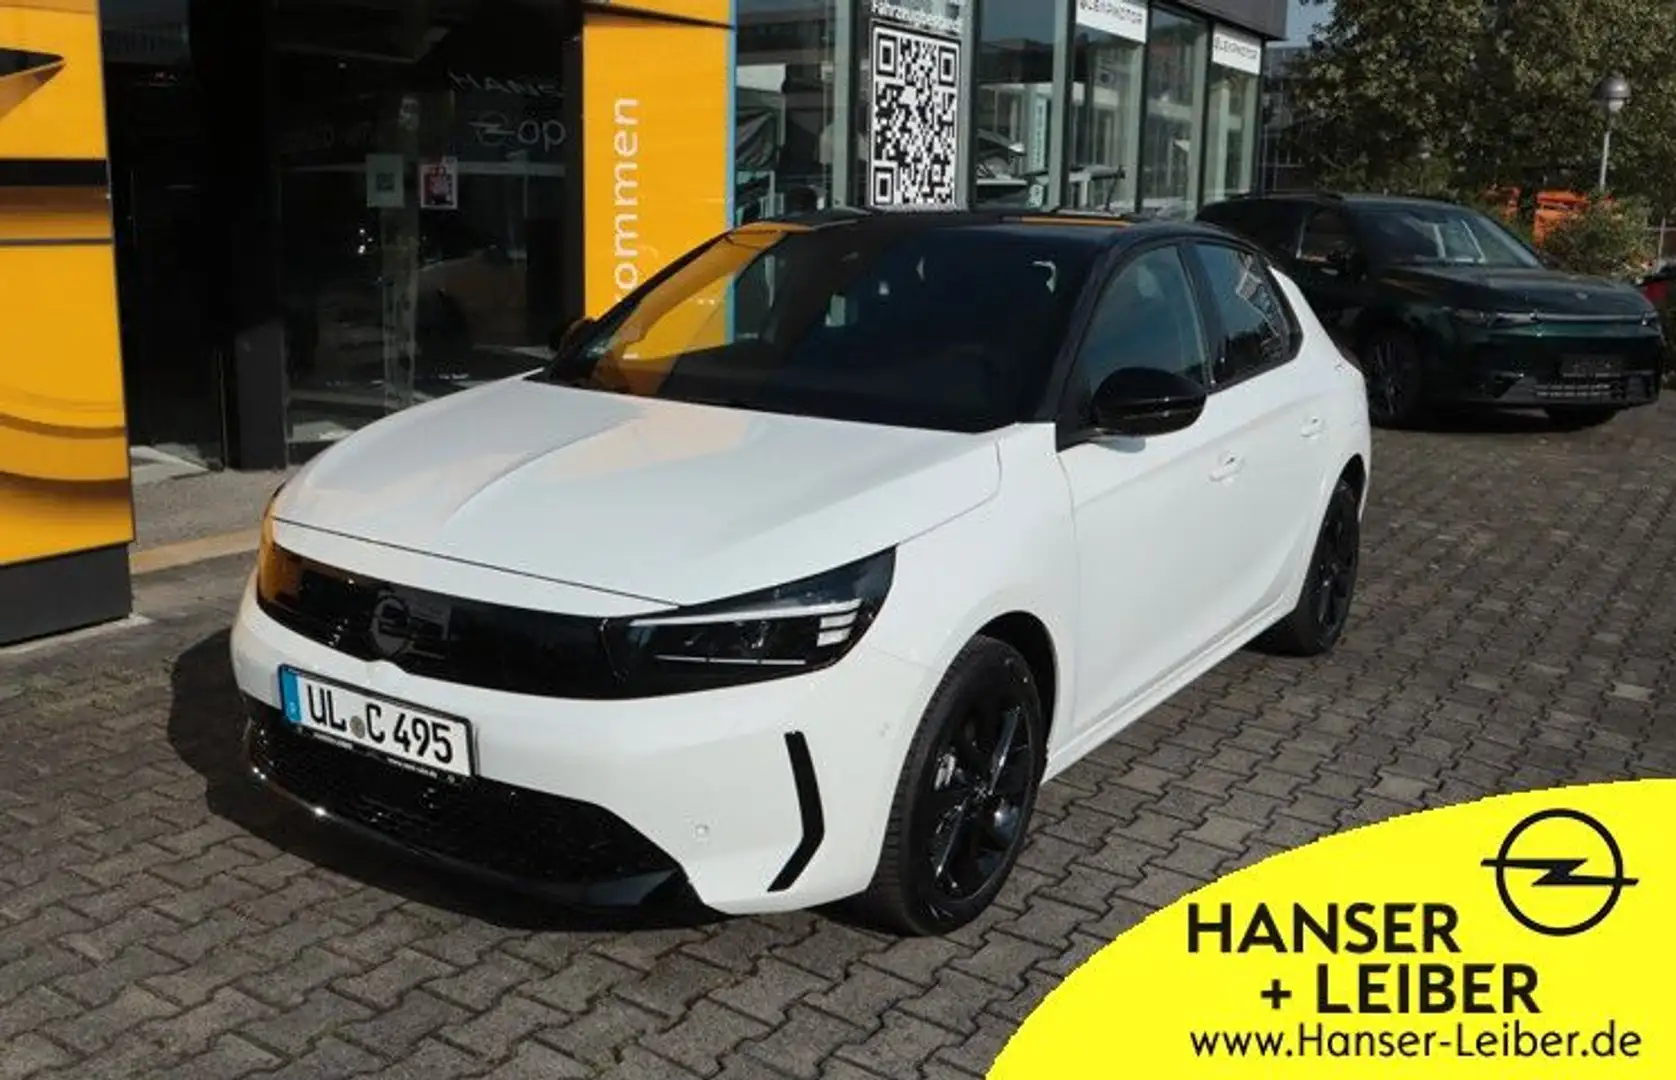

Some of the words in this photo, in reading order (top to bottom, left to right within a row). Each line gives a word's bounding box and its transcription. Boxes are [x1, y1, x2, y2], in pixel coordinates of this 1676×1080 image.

[614, 97, 640, 301] ommen
[307, 684, 348, 732] UL
[365, 703, 385, 744] C
[392, 712, 454, 764] 495
